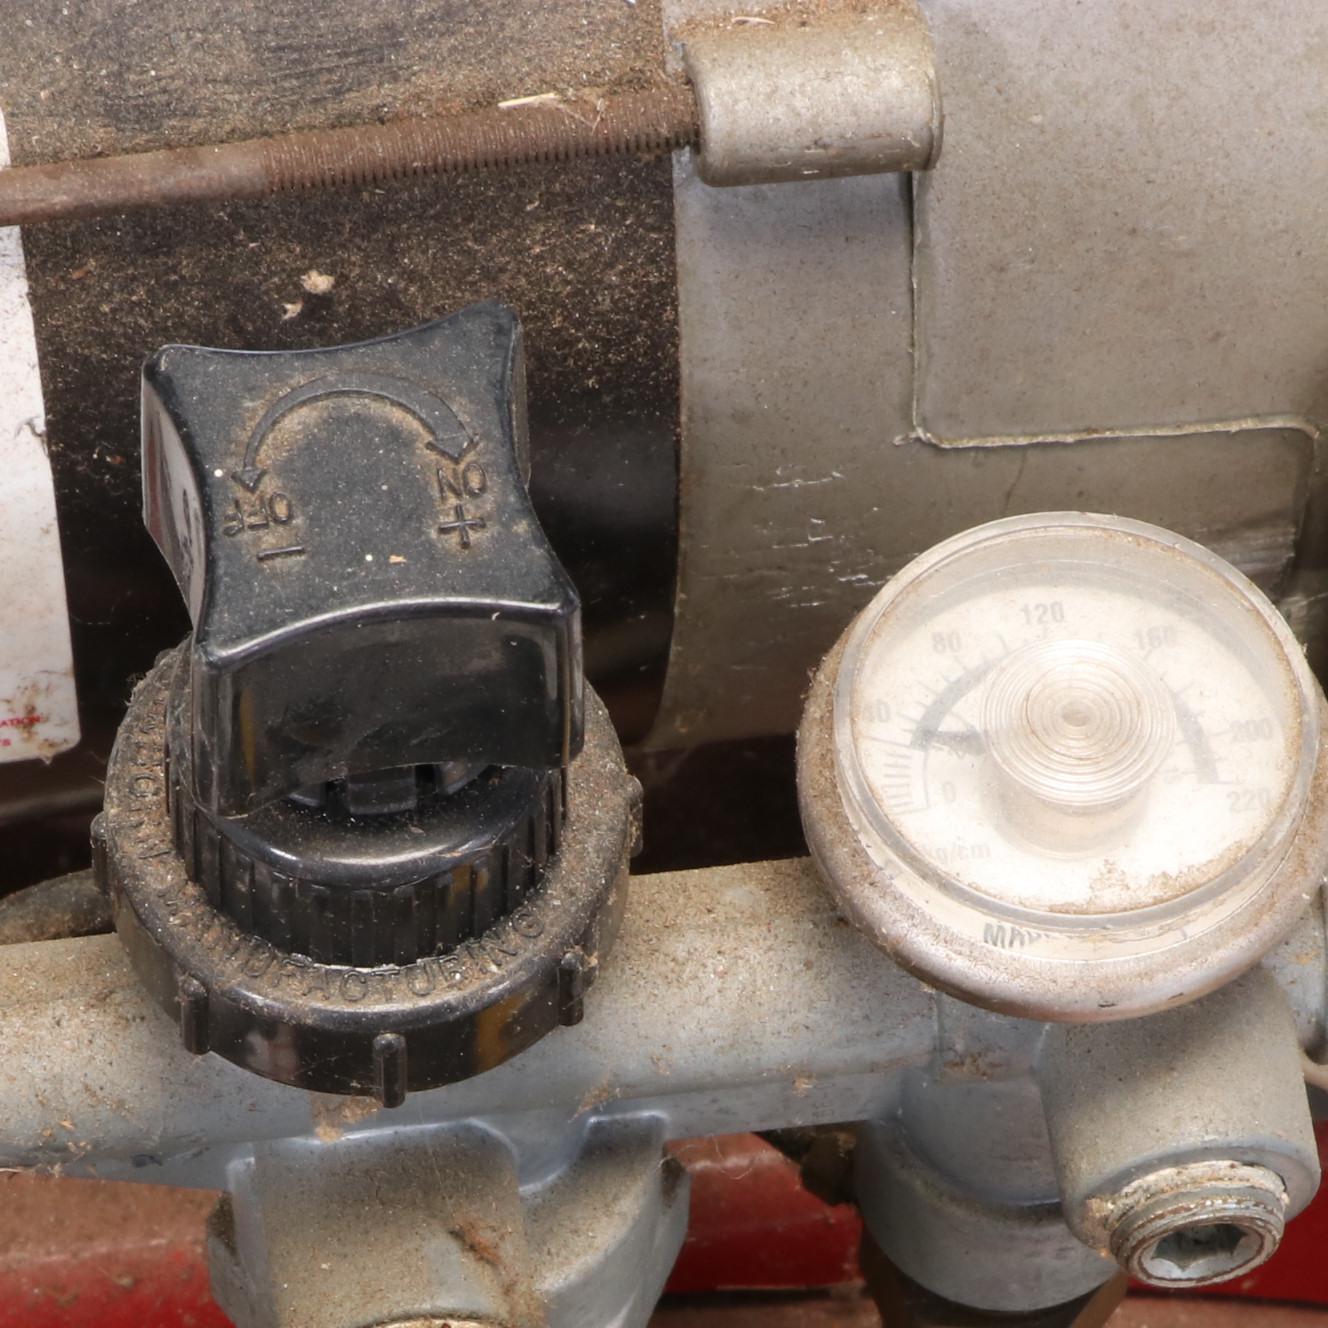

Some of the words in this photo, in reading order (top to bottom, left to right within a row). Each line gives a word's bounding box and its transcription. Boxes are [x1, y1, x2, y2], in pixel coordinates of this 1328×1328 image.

[437, 462, 488, 501] ON
[1020, 601, 1065, 625] 120
[932, 630, 961, 654] 80
[1229, 788, 1271, 813] 220
